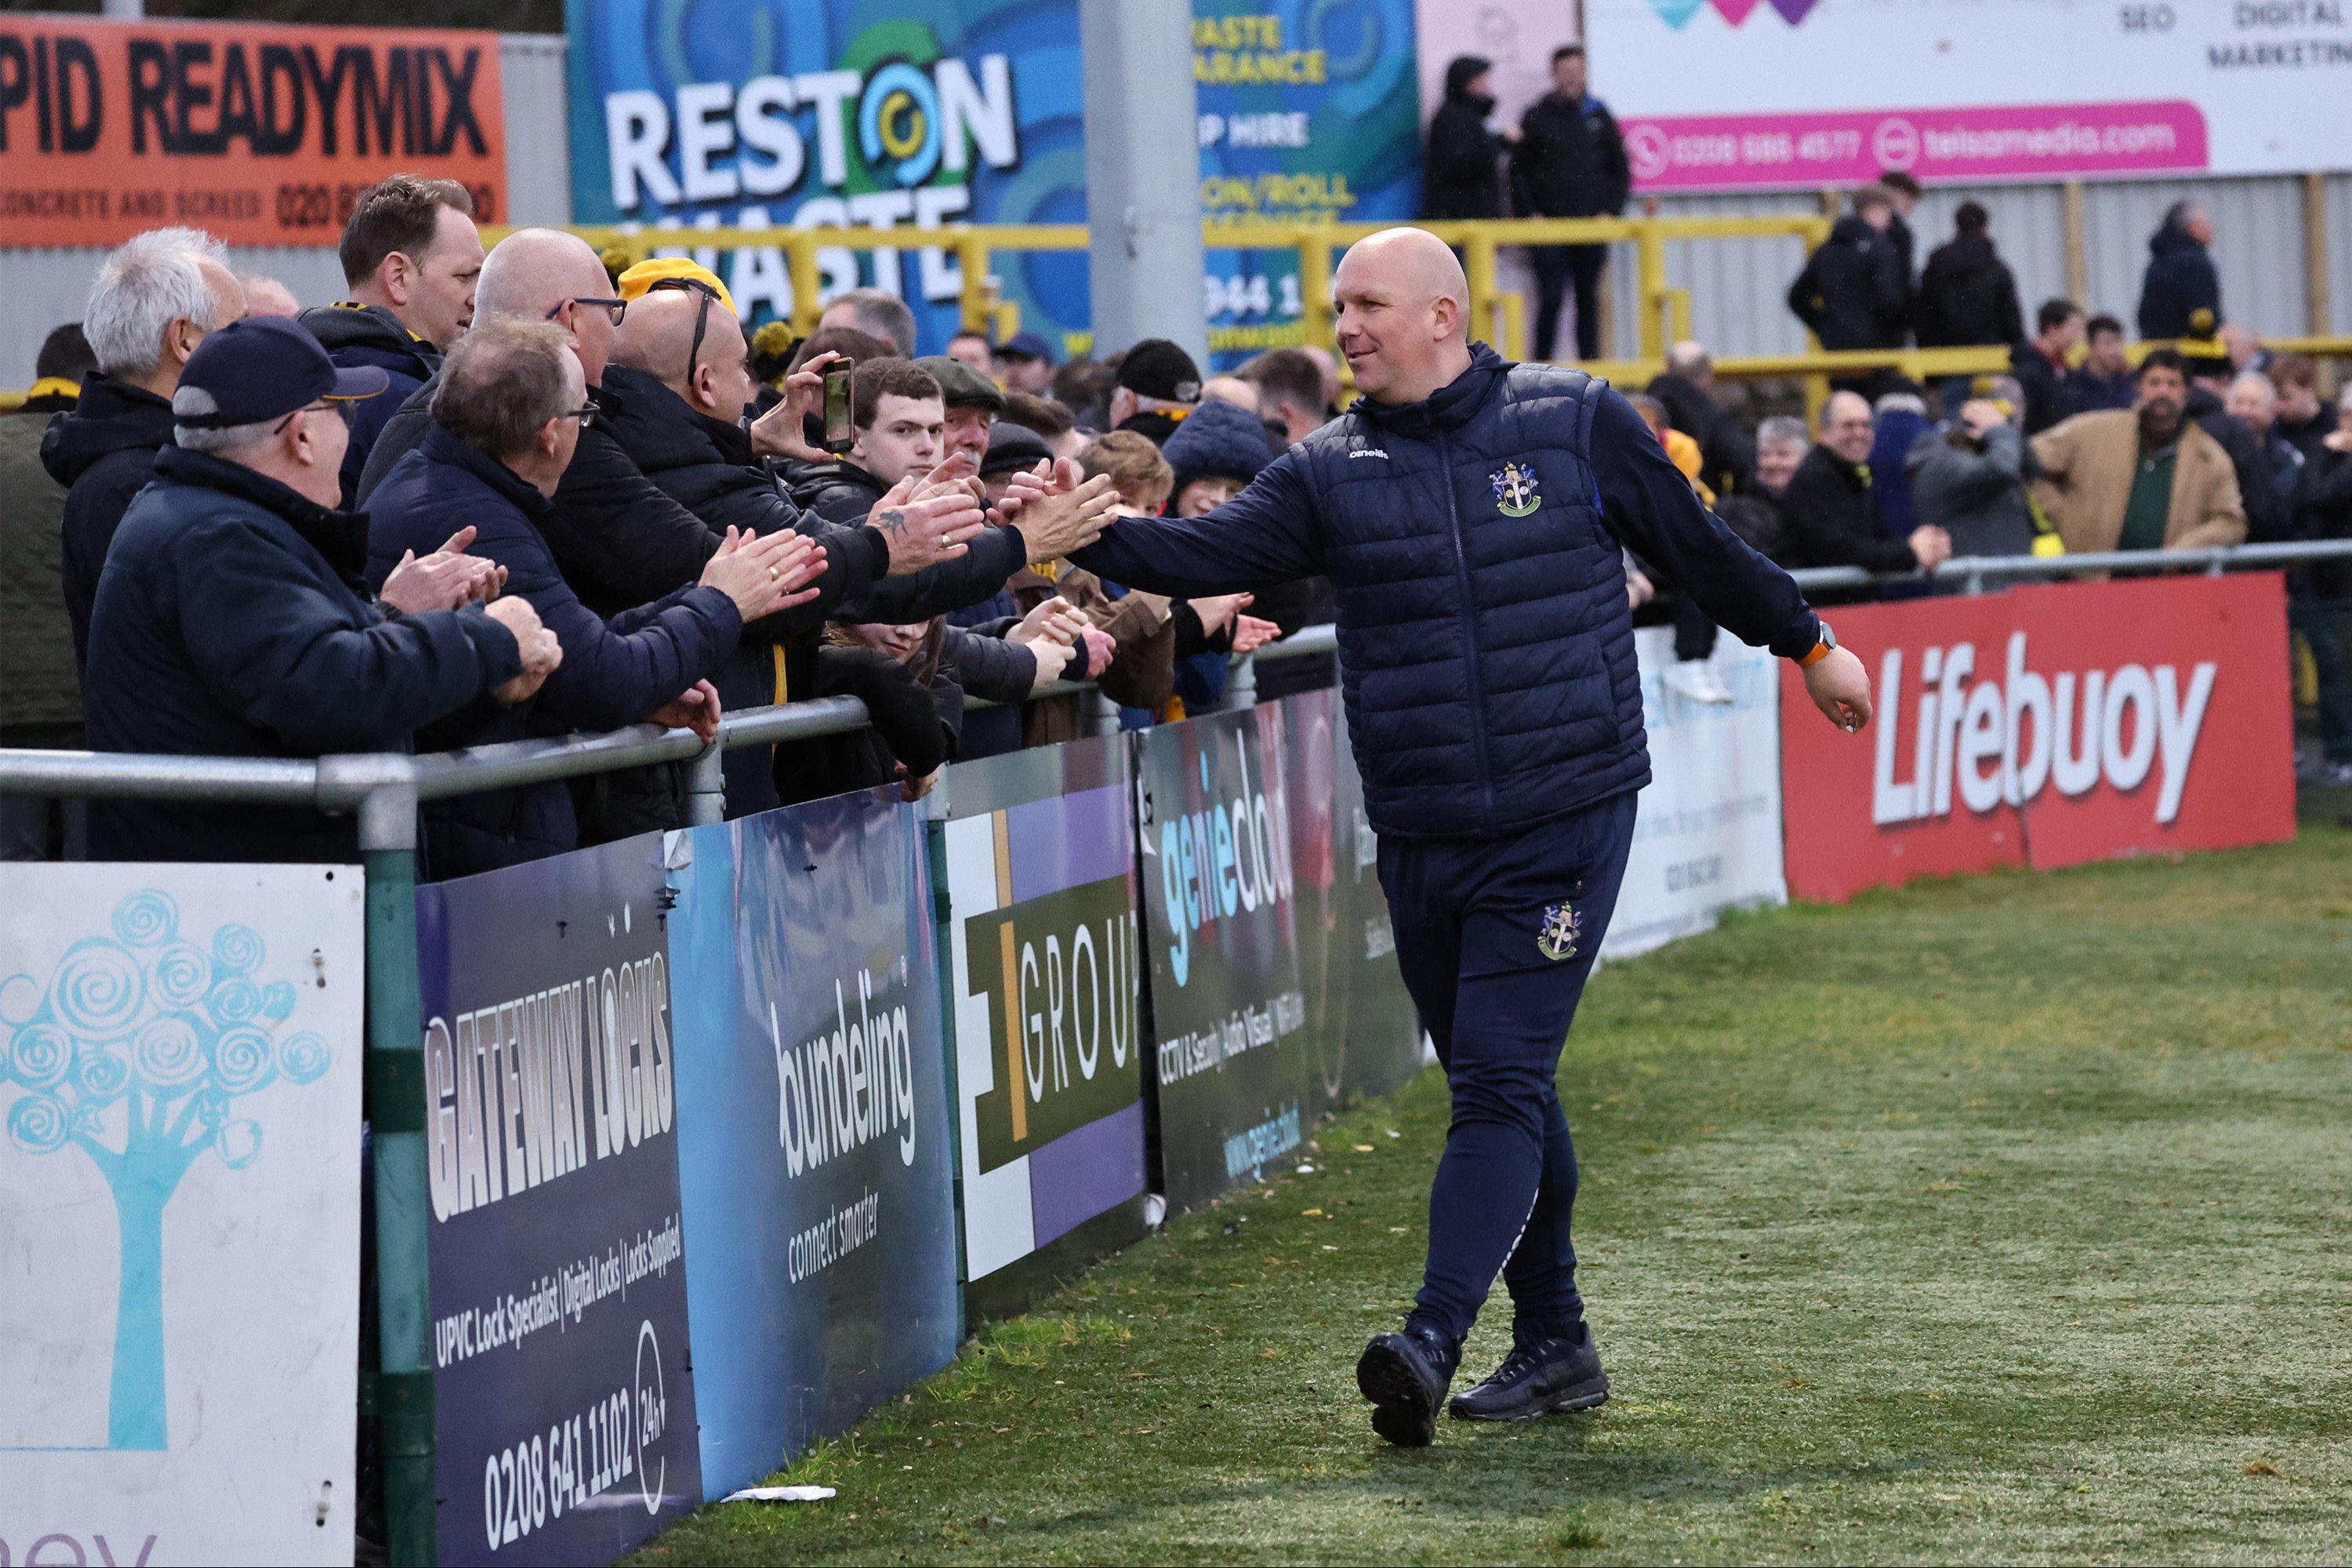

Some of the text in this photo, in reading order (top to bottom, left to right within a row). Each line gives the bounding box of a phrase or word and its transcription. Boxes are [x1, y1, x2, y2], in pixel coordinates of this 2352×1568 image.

[2119, 2, 2178, 33] SEO
[2233, 0, 2344, 30] DIGITAL
[128, 37, 487, 156] READYMIX
[605, 53, 1018, 211] RESTON
[1228, 112, 1310, 147] HIRE
[0, 187, 110, 220] ONCRETE
[118, 188, 165, 221] AND
[1871, 630, 2218, 825] Lifebuoy
[424, 950, 673, 1224] GATEWAY LOCKS
[770, 967, 916, 1179] bundeling
[1158, 1037, 1185, 1086] CCTV
[788, 1185, 880, 1284] connect smarter
[435, 1212, 681, 1368] UPVC Lock Specialist Digital Locks Locks Supplied
[485, 1387, 633, 1552] 0208 641 1102
[641, 1385, 661, 1447] 24h
